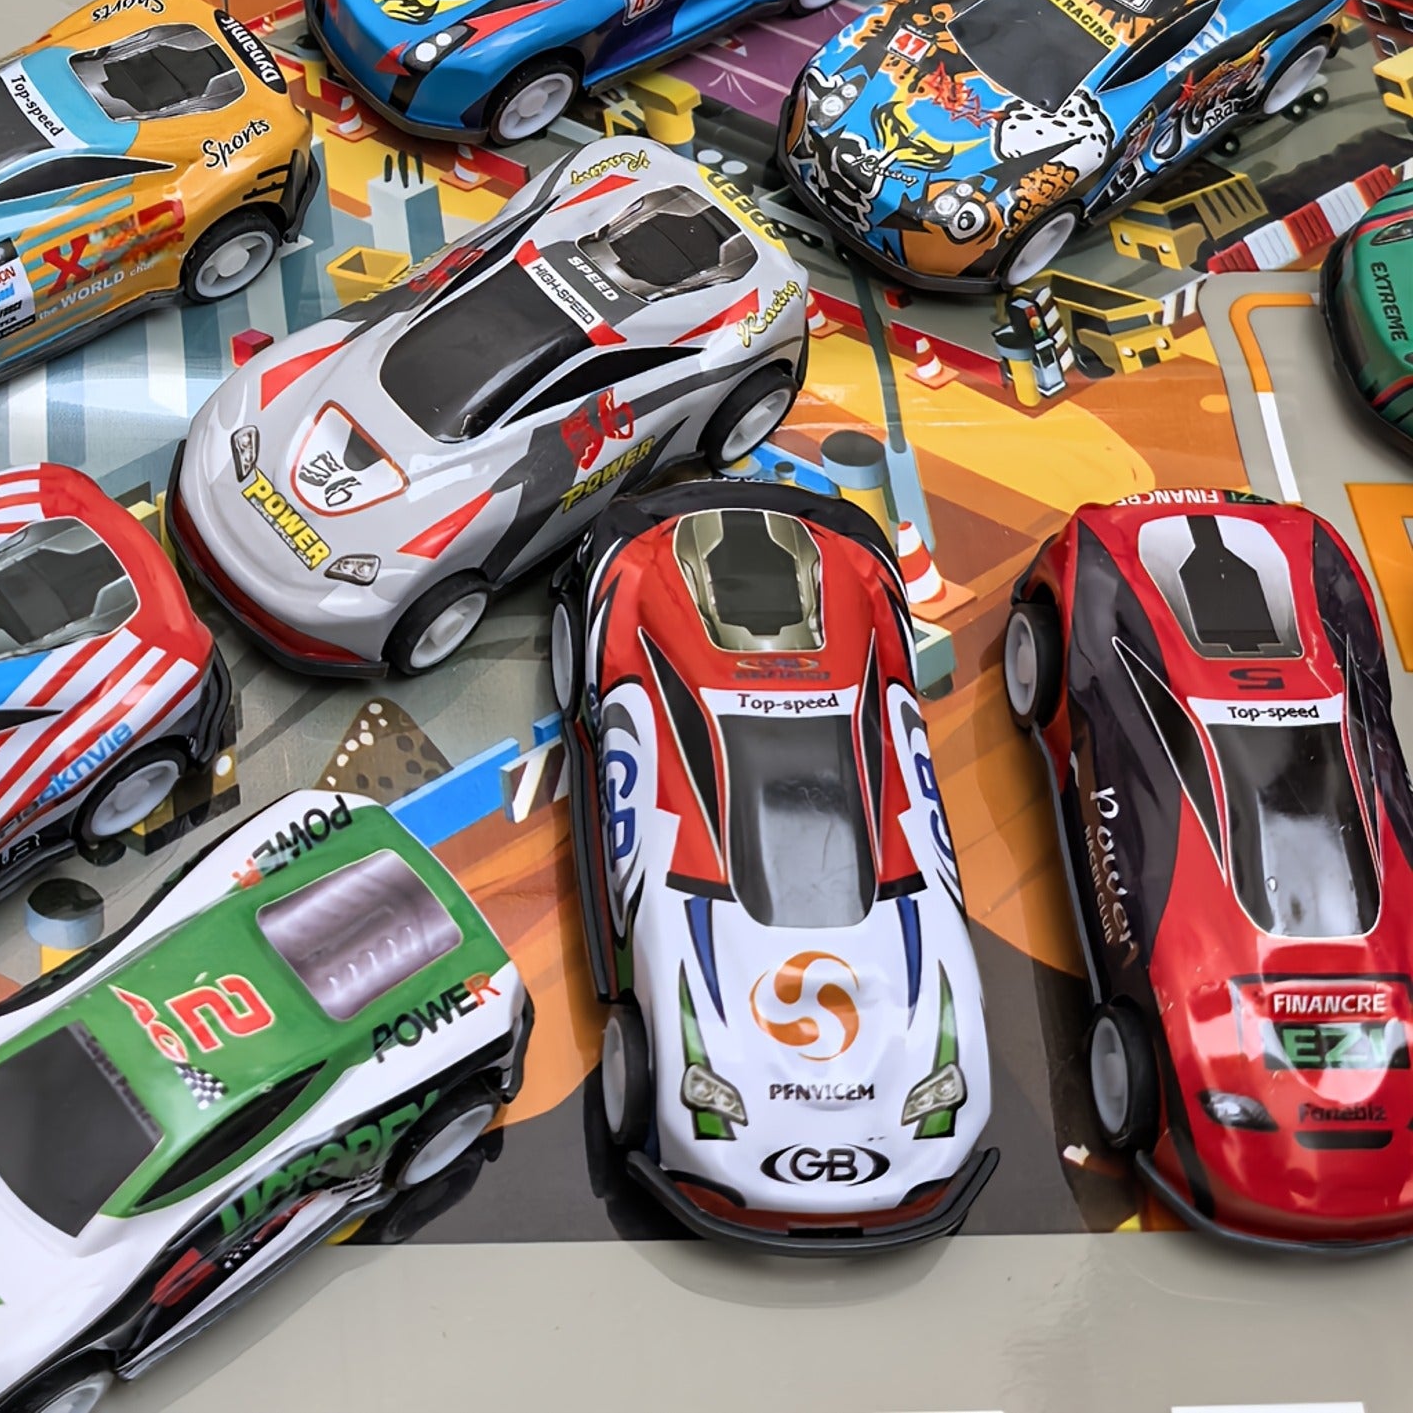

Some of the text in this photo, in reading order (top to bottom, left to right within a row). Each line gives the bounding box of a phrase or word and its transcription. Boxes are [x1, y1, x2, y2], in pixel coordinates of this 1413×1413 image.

[219, 15, 282, 85] Dynamic
[891, 33, 926, 59] 47
[9, 73, 66, 138] Top-speed
[200, 117, 272, 170] Sports
[60, 269, 126, 309] WORLD
[531, 263, 597, 326] HIGH-SPEED
[566, 255, 620, 303] SPEED
[1370, 261, 1409, 342] EXTREME
[736, 279, 804, 349] Racing
[560, 434, 657, 514] POWER
[1113, 488, 1220, 508] FINANCRE
[241, 466, 332, 571] POWER
[736, 691, 841, 716] Top-speed
[1227, 704, 1320, 723] Top-speed
[164, 974, 276, 1054] 2
[371, 971, 502, 1063] POWER
[1272, 993, 1388, 1014] FINANCRE
[1282, 1026, 1387, 1063] EZI
[788, 1146, 858, 1183] GB
